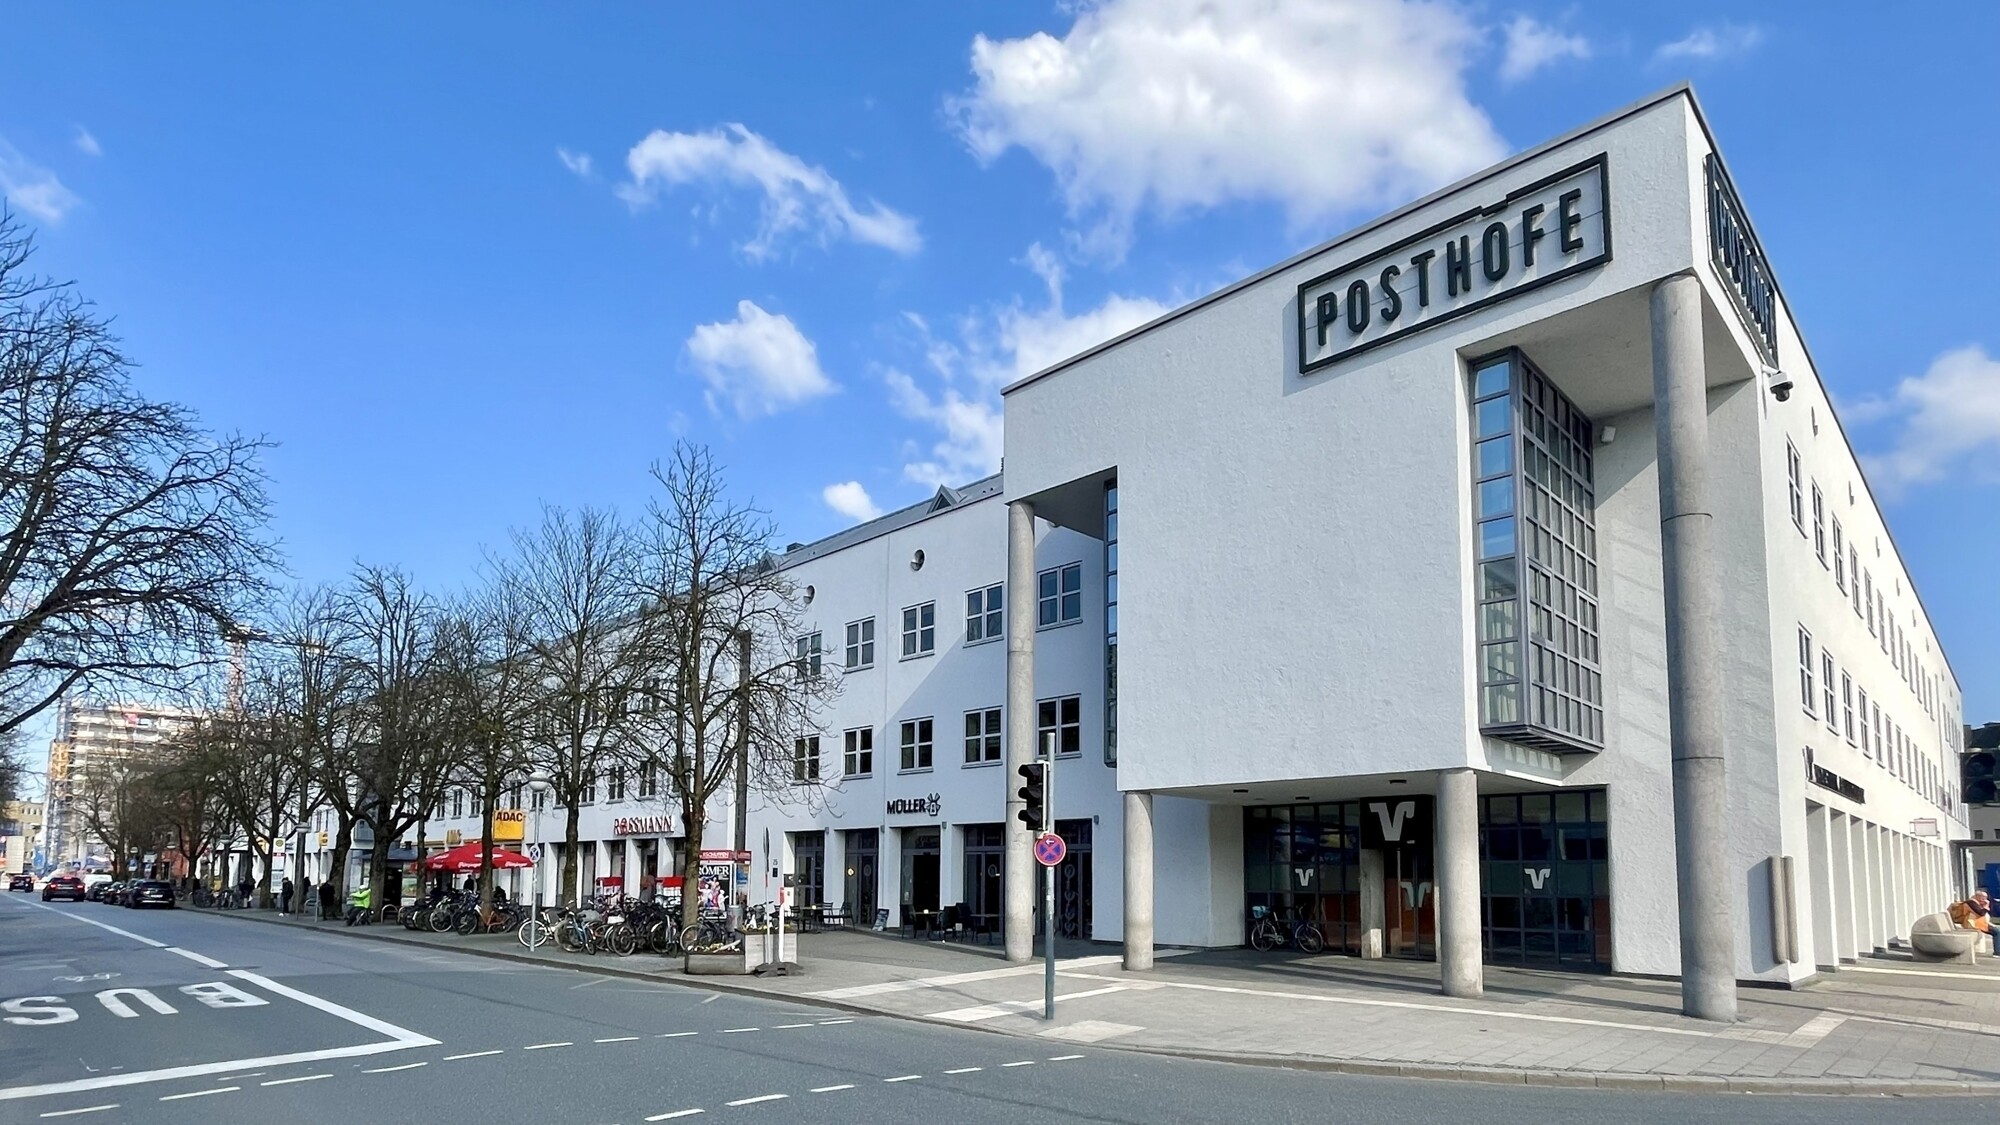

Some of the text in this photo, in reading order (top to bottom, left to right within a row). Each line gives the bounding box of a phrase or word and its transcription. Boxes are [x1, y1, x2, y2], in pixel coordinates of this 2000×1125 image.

[495, 811, 523, 822] ADAC
[614, 815, 674, 835] ROSSMANN
[0, 981, 271, 1026] BUS
